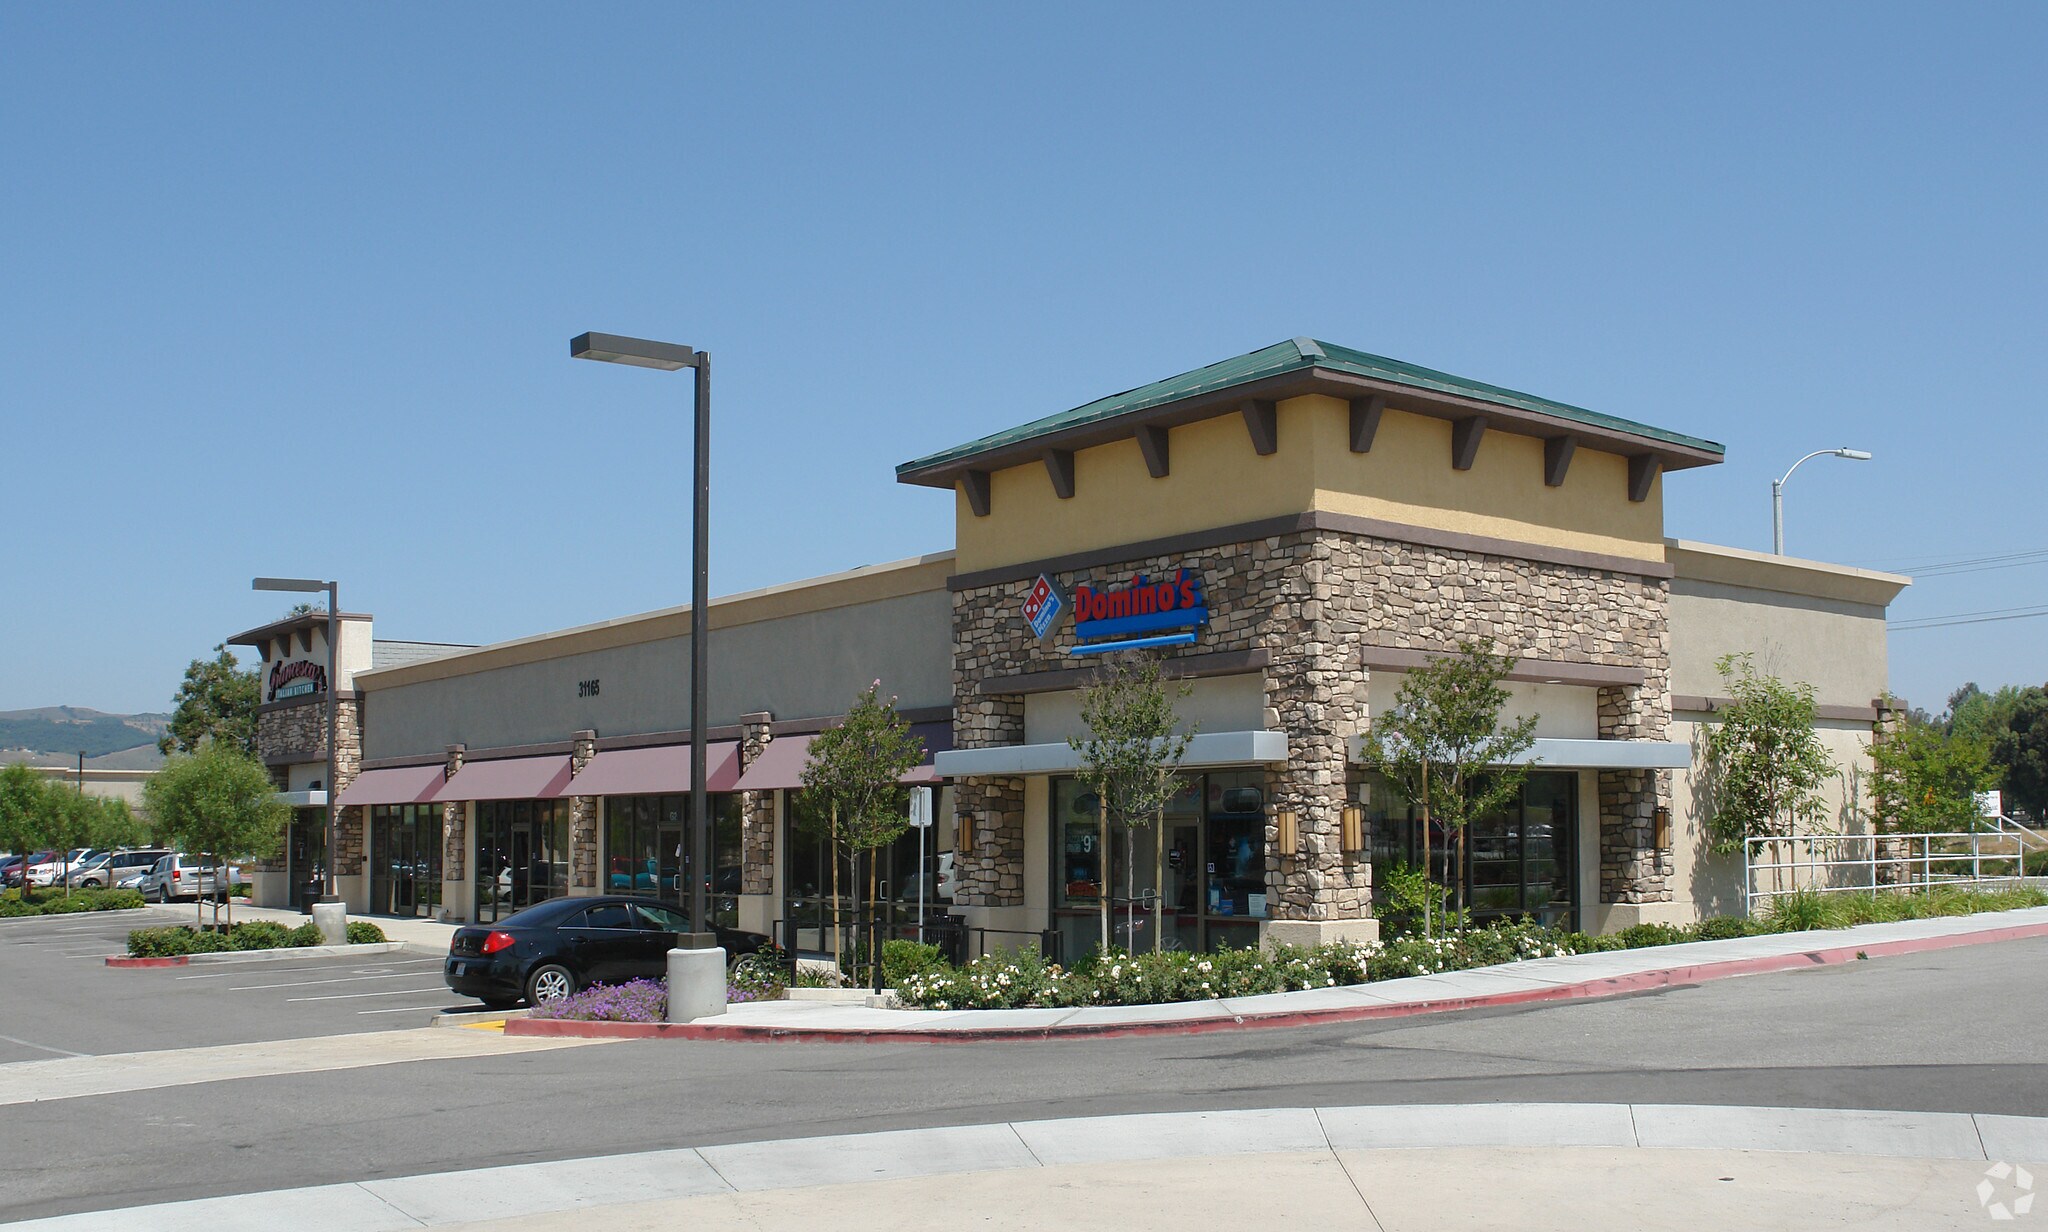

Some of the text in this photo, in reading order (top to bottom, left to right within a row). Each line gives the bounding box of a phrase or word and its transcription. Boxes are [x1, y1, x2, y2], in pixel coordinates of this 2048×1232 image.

[1076, 568, 1196, 623] Domino's
[1033, 594, 1055, 628] Domino's
[1037, 613, 1052, 635] Pizza
[578, 679, 600, 698] 31165
